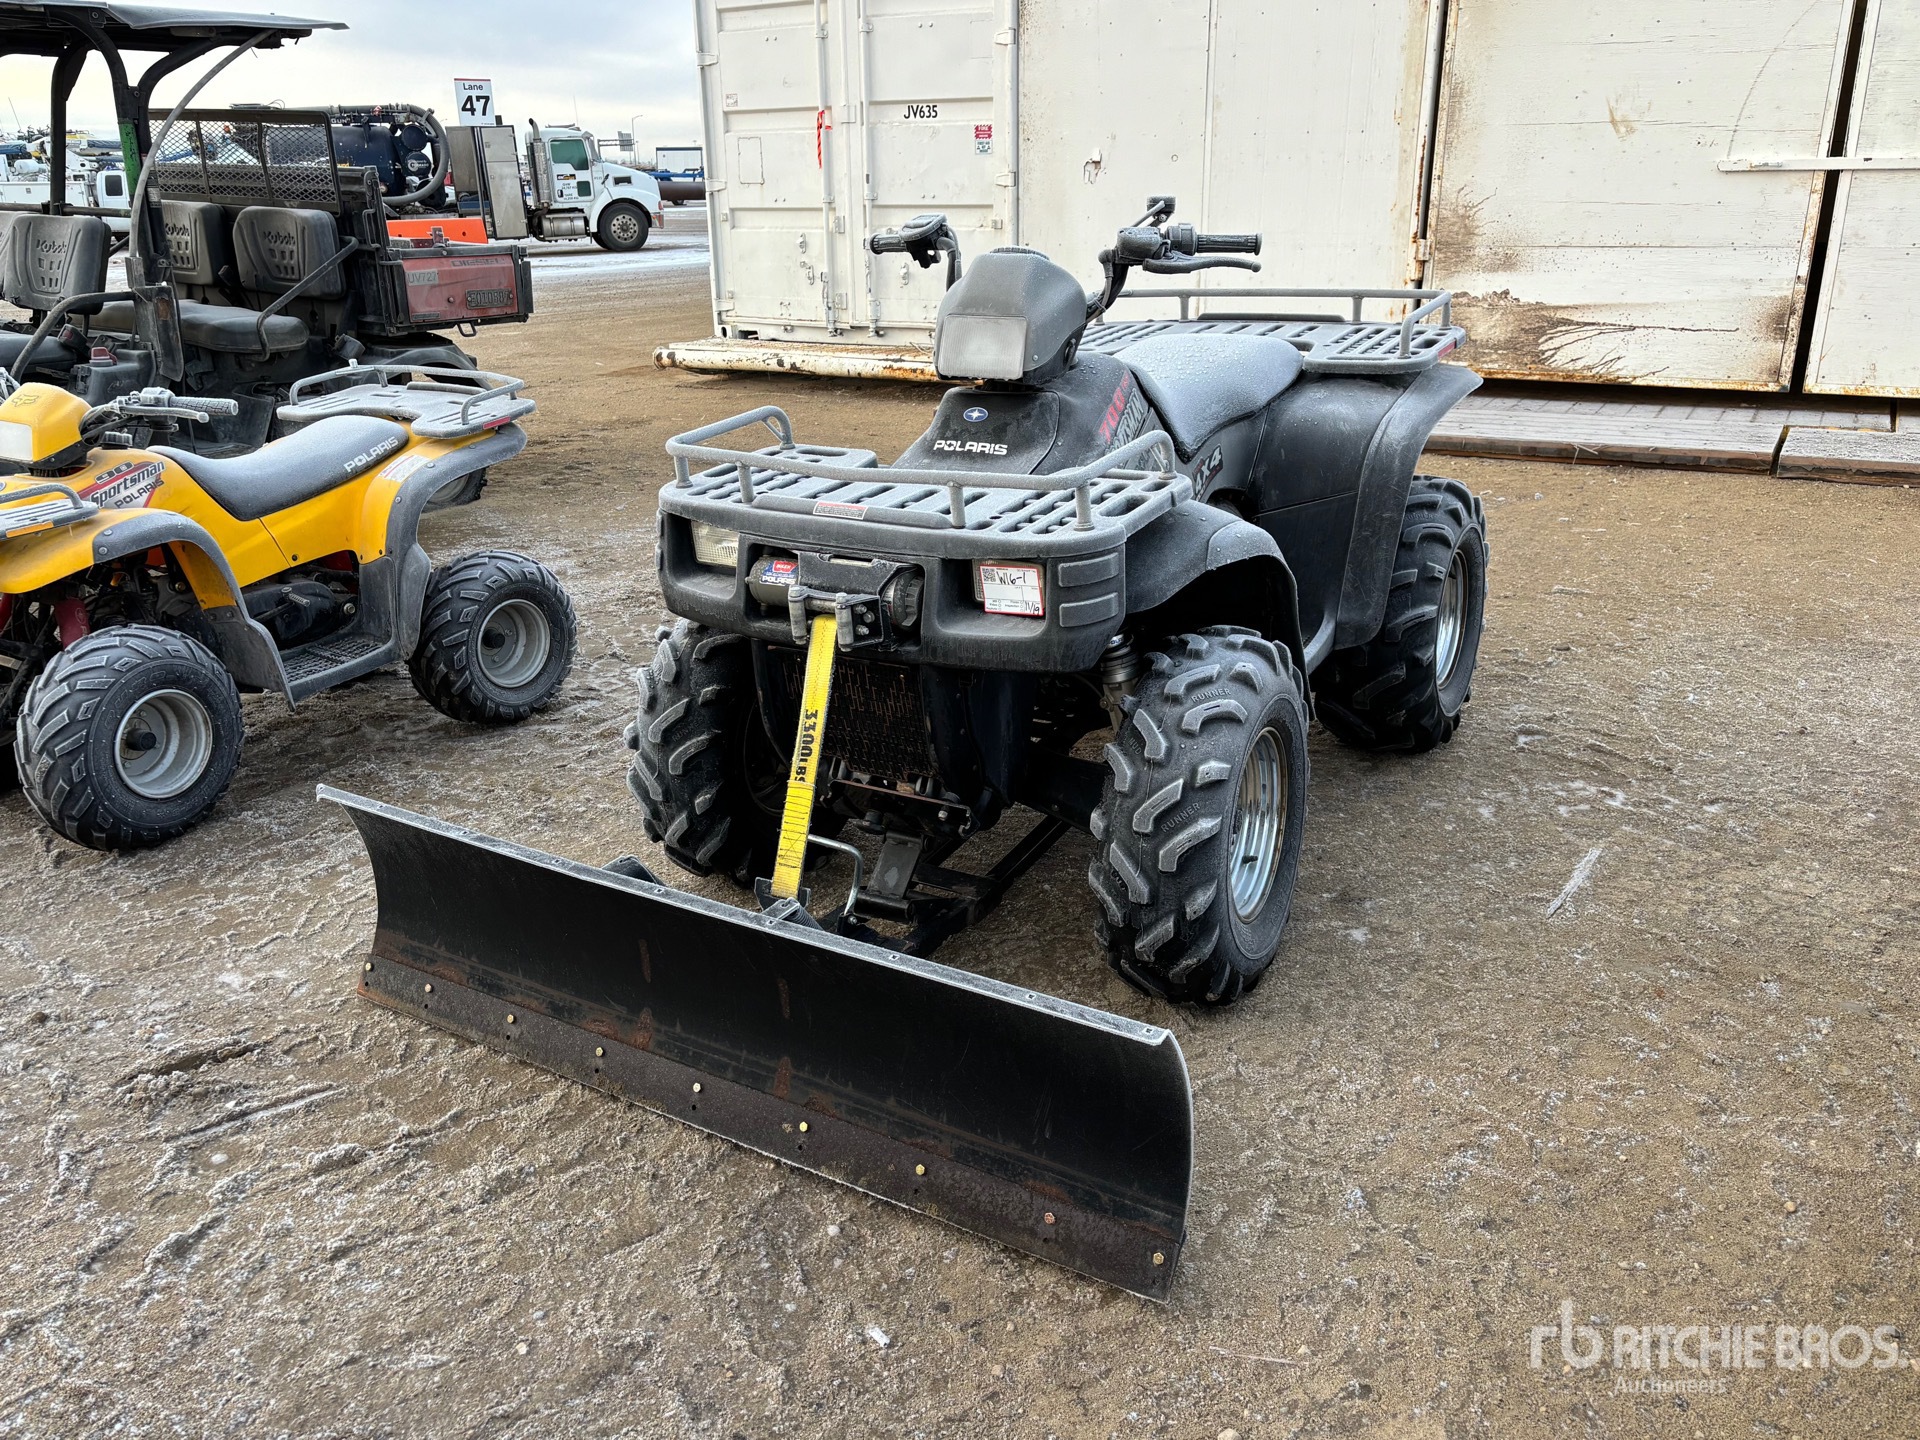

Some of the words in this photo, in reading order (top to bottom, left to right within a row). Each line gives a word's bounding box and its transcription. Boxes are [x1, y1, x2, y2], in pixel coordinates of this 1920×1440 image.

[462, 82, 484, 91] Lane
[461, 95, 490, 117] 47
[903, 104, 938, 119] JV635
[263, 231, 296, 245] Kubota
[36, 239, 67, 254] Kubota
[407, 271, 438, 284] UV727
[343, 436, 399, 473] POLARIS
[933, 440, 1008, 455] POLARIS
[91, 461, 165, 508] Sportsman
[114, 478, 165, 508] POLARIS
[762, 575, 796, 585] POLARIS
[1190, 687, 1232, 703] RUNNER
[1160, 802, 1201, 832] RUNNER
